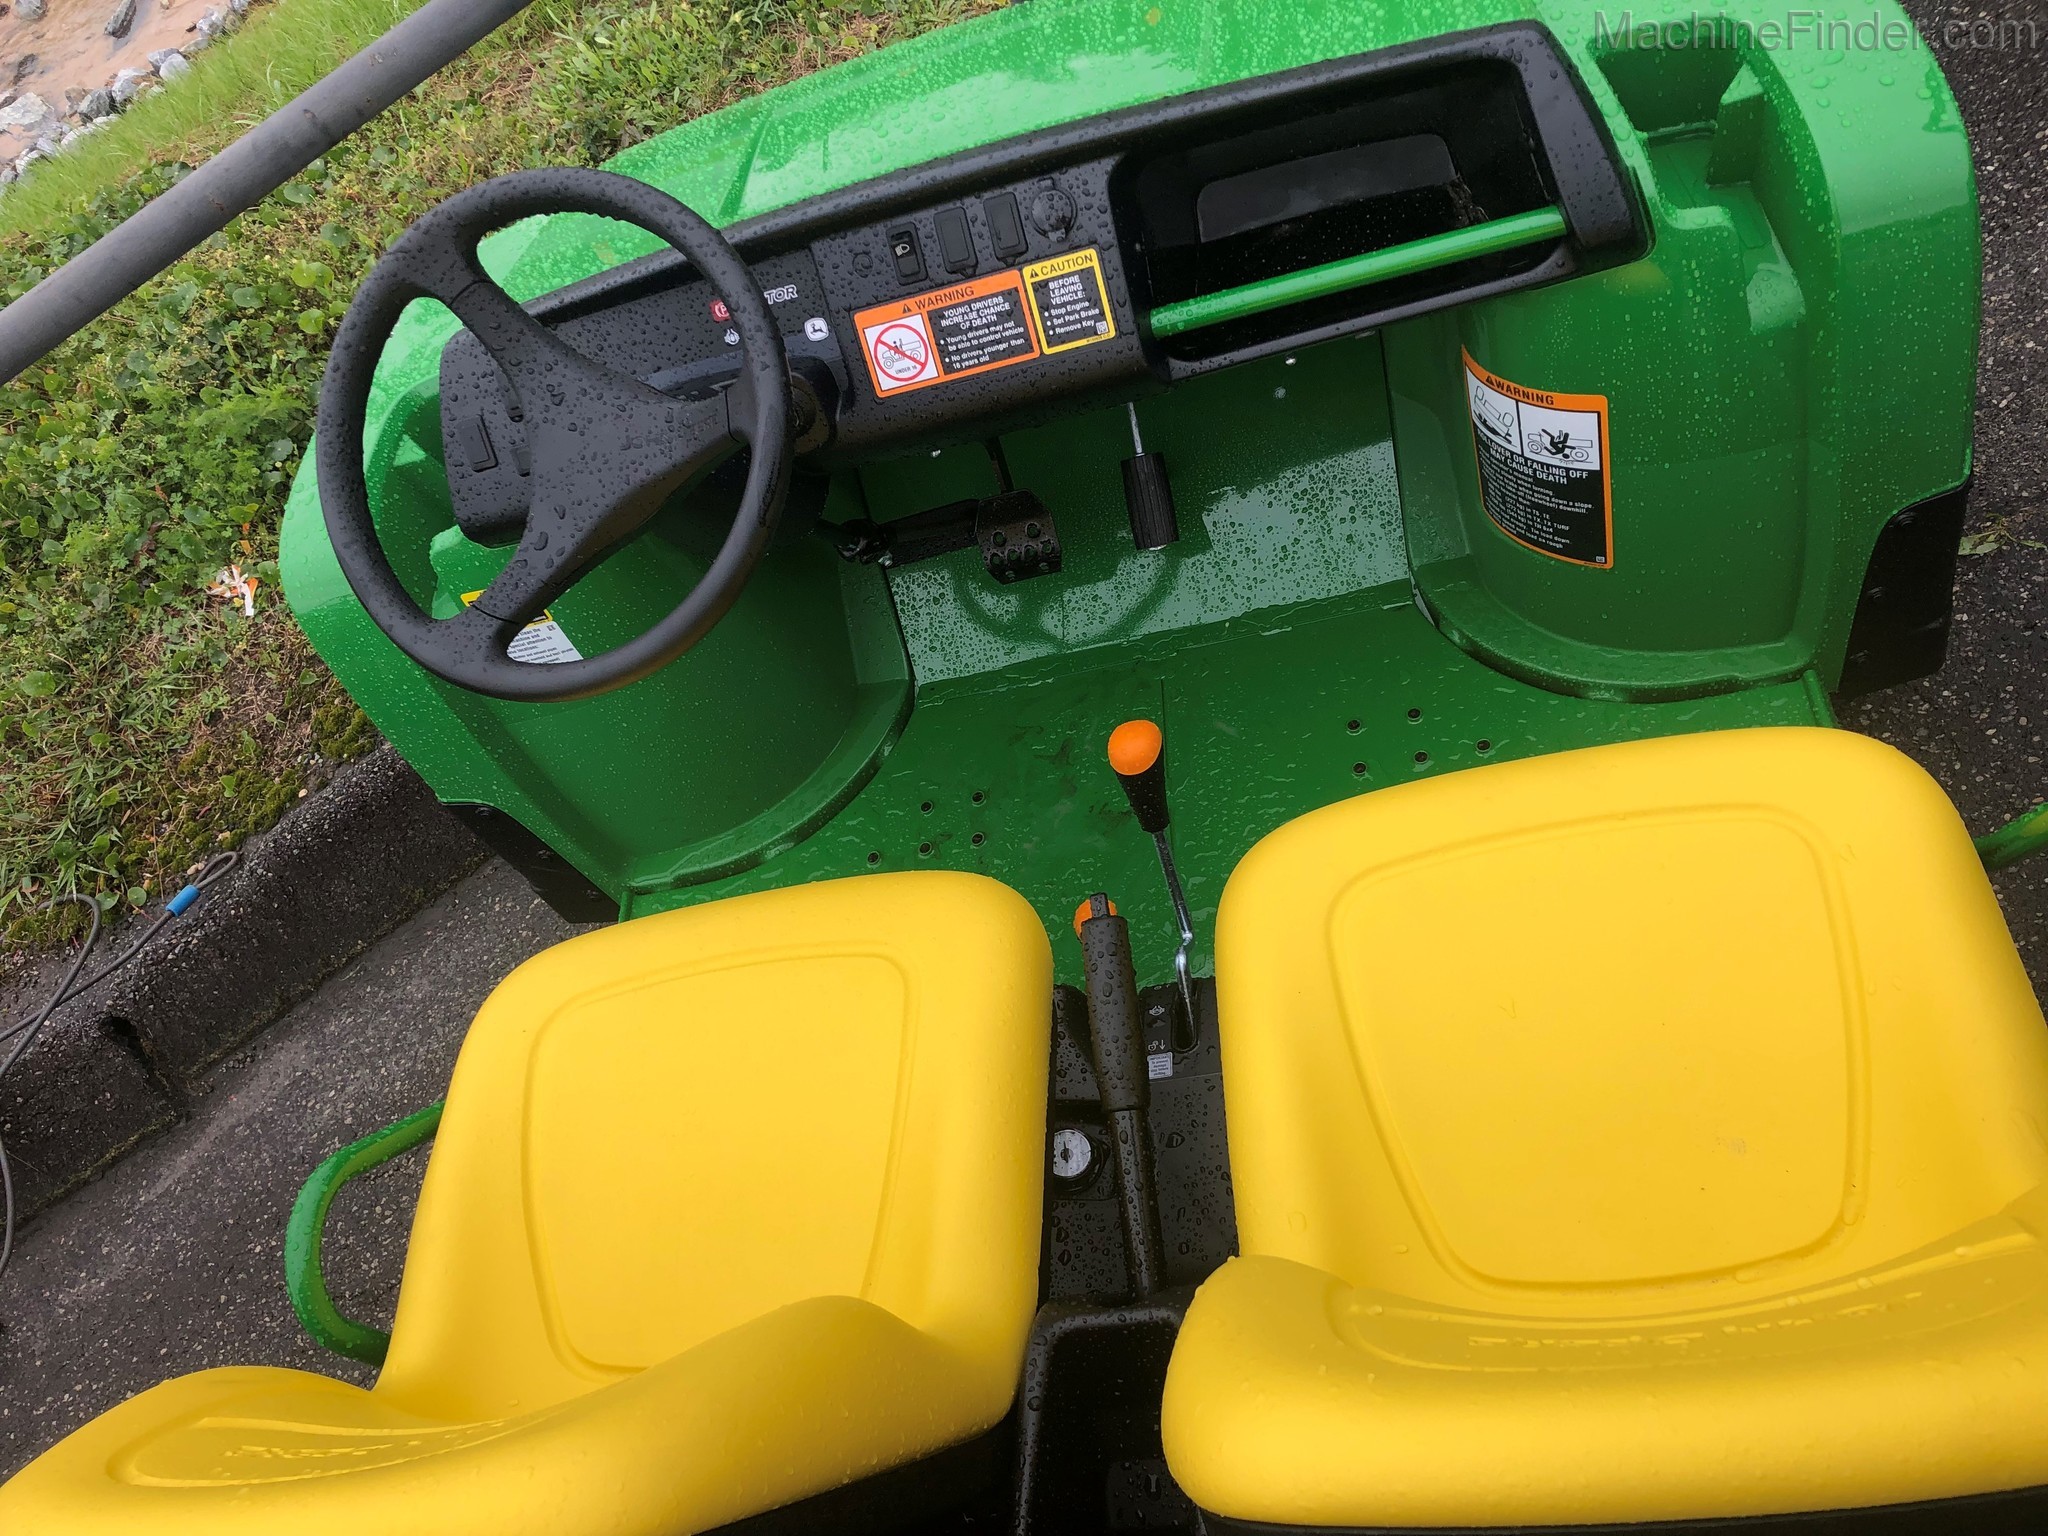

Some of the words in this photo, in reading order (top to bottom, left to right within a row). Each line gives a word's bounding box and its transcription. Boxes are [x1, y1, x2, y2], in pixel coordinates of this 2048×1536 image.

[1040, 254, 1094, 276] CAUTION
[1048, 275, 1080, 290] BEFORE
[1050, 283, 1083, 298] LEAVING
[764, 284, 798, 304] TOR
[914, 286, 974, 310] WARNING
[1050, 291, 1086, 305] VEHICLE:
[941, 312, 978, 326] INCREASE
[980, 302, 1010, 316] CHANCE
[944, 306, 970, 318] YOUNG
[971, 296, 1004, 310] DRIVERS
[1051, 307, 1066, 316] Stop
[1067, 301, 1090, 312] Engine
[1065, 314, 1080, 322] Park
[1080, 308, 1100, 318] Brake
[960, 320, 971, 330] OF
[972, 315, 997, 327] DEATH
[1056, 324, 1082, 334] Remove
[1082, 320, 1094, 328] Key
[946, 334, 966, 344] Young
[967, 328, 988, 338] drivers
[990, 324, 1003, 334] may
[1004, 320, 1014, 328] not
[958, 341, 970, 350] able
[980, 334, 1001, 344] control
[1002, 326, 1024, 338] vehicle
[962, 350, 982, 360] drivers
[984, 342, 1009, 354] younger
[1010, 338, 1025, 346] than
[895, 366, 912, 374] UNDER
[962, 359, 978, 368] years
[1494, 378, 1554, 405] WARNING
[1490, 448, 1505, 462] MAY
[1508, 459, 1534, 476] CAUSE
[1536, 470, 1567, 485] DEATH
[1514, 456, 1525, 465] OR
[1528, 459, 1566, 476] FALLING
[1569, 470, 1588, 479] OFF
[1533, 491, 1549, 501] going
[1574, 501, 1594, 509] slope.
[1558, 503, 1588, 514] downhill.
[1553, 522, 1570, 531] TURF
[1540, 530, 1552, 539] load
[1553, 534, 1571, 544] down.
